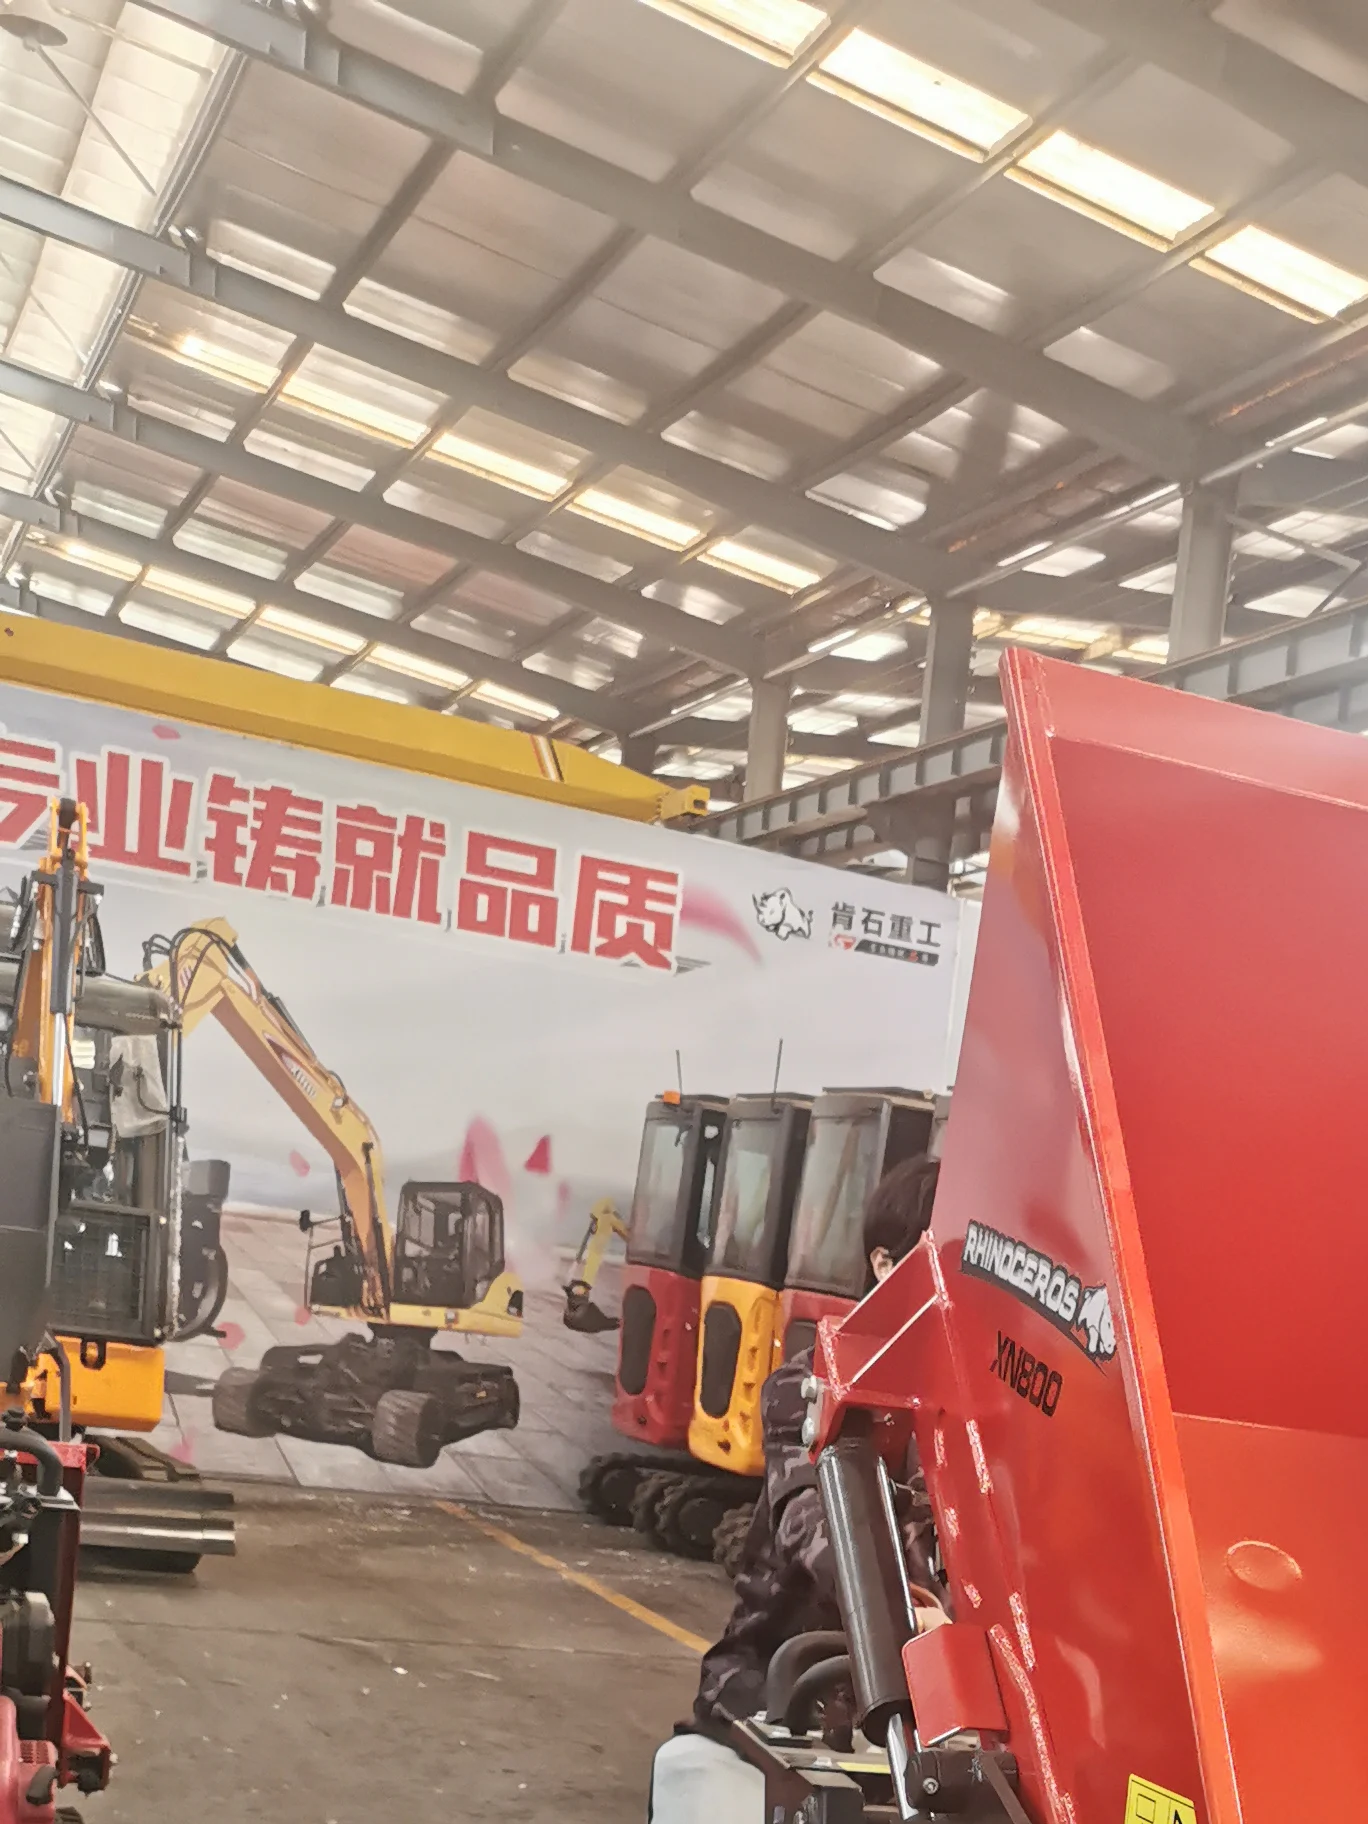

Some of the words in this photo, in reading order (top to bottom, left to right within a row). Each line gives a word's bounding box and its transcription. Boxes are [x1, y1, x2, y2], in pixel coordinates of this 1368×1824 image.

[830, 901, 941, 948] 肯石重工
[962, 1223, 1081, 1323] RHINOCEROS
[989, 1330, 1063, 1417] XN800
